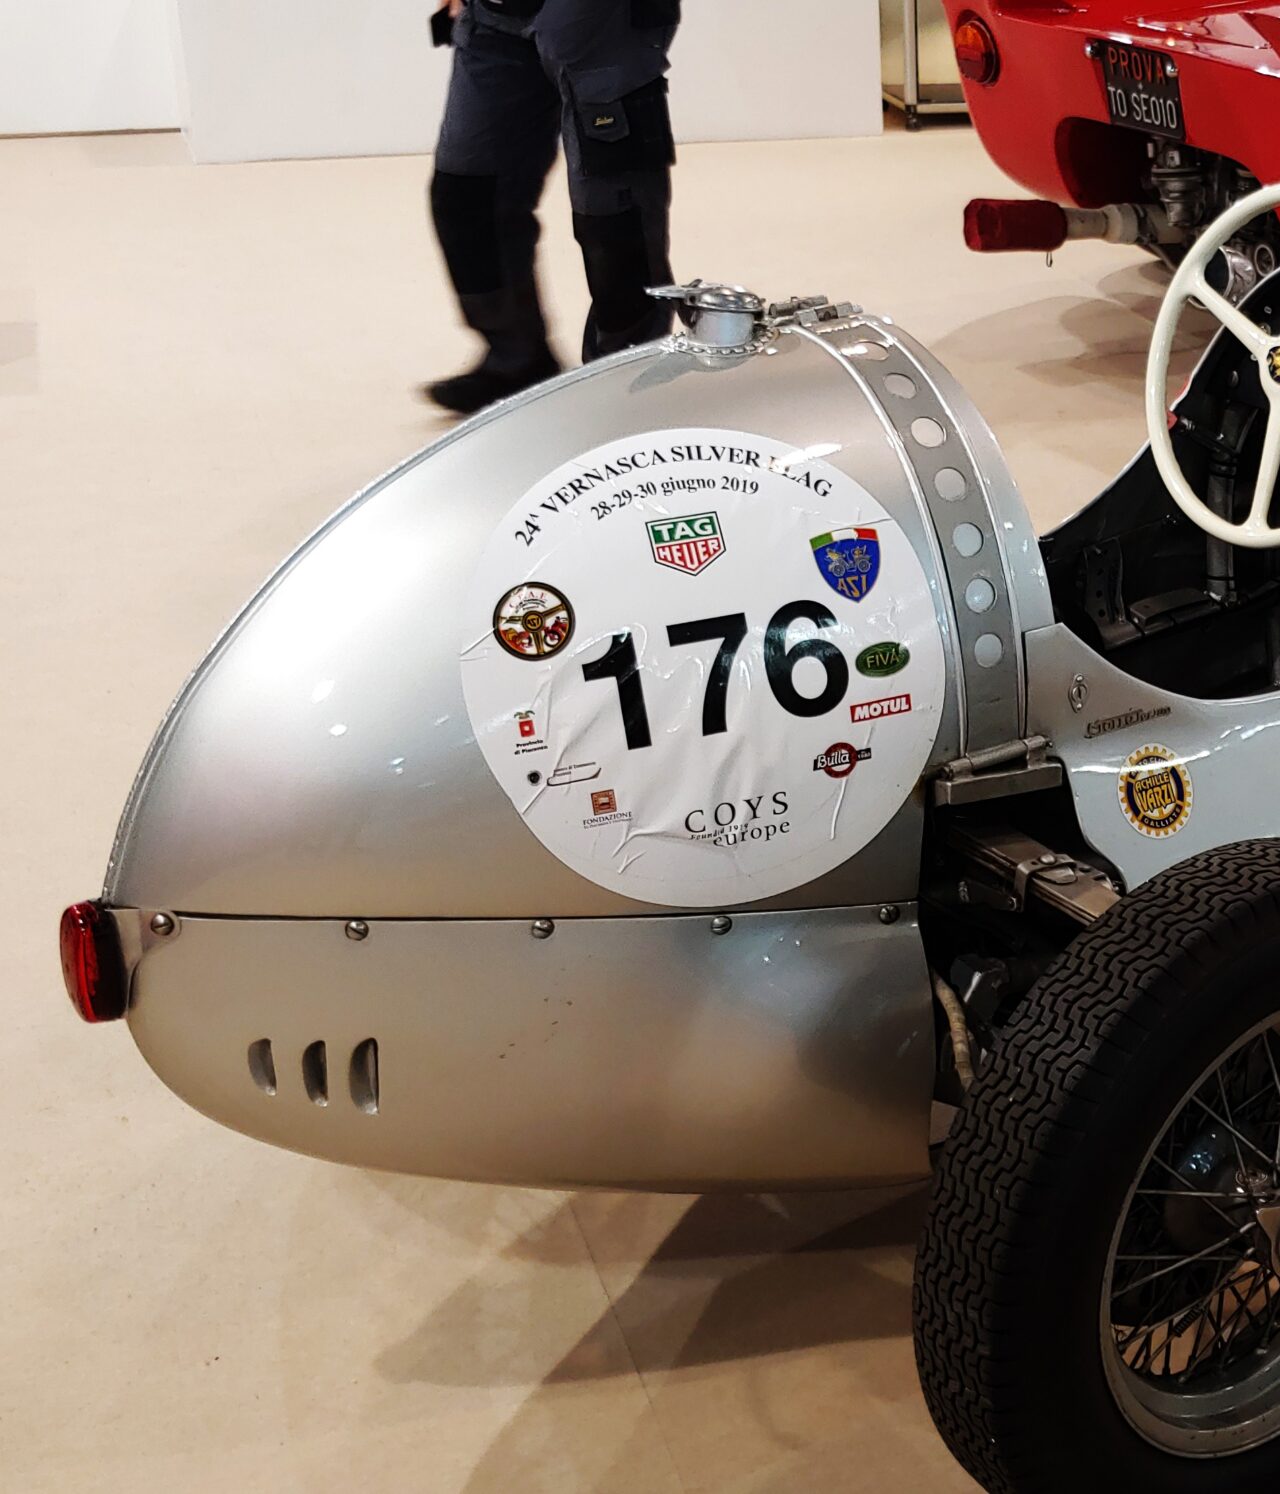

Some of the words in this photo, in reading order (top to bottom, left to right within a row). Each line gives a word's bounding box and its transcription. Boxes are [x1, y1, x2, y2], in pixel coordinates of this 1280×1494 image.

[1108, 47, 1166, 85] PROVA
[1107, 86, 1128, 117] TO
[540, 449, 667, 514] VERNASCA
[670, 445, 761, 468] SILVER
[590, 482, 657, 520] 28-29-30
[661, 477, 716, 496] giugno
[721, 476, 759, 495] 2019
[654, 518, 714, 542] TAG
[658, 539, 720, 570] HEUER
[866, 648, 899, 668] FIVA
[581, 599, 850, 751] 176
[854, 697, 909, 721] MOTUL
[817, 750, 850, 769] Bulla
[1135, 771, 1170, 792] ACHILLE
[685, 791, 789, 833] COYS
[1137, 782, 1176, 813] VARZI
[583, 811, 632, 826] FONDAZIONE
[713, 821, 790, 847] europe
